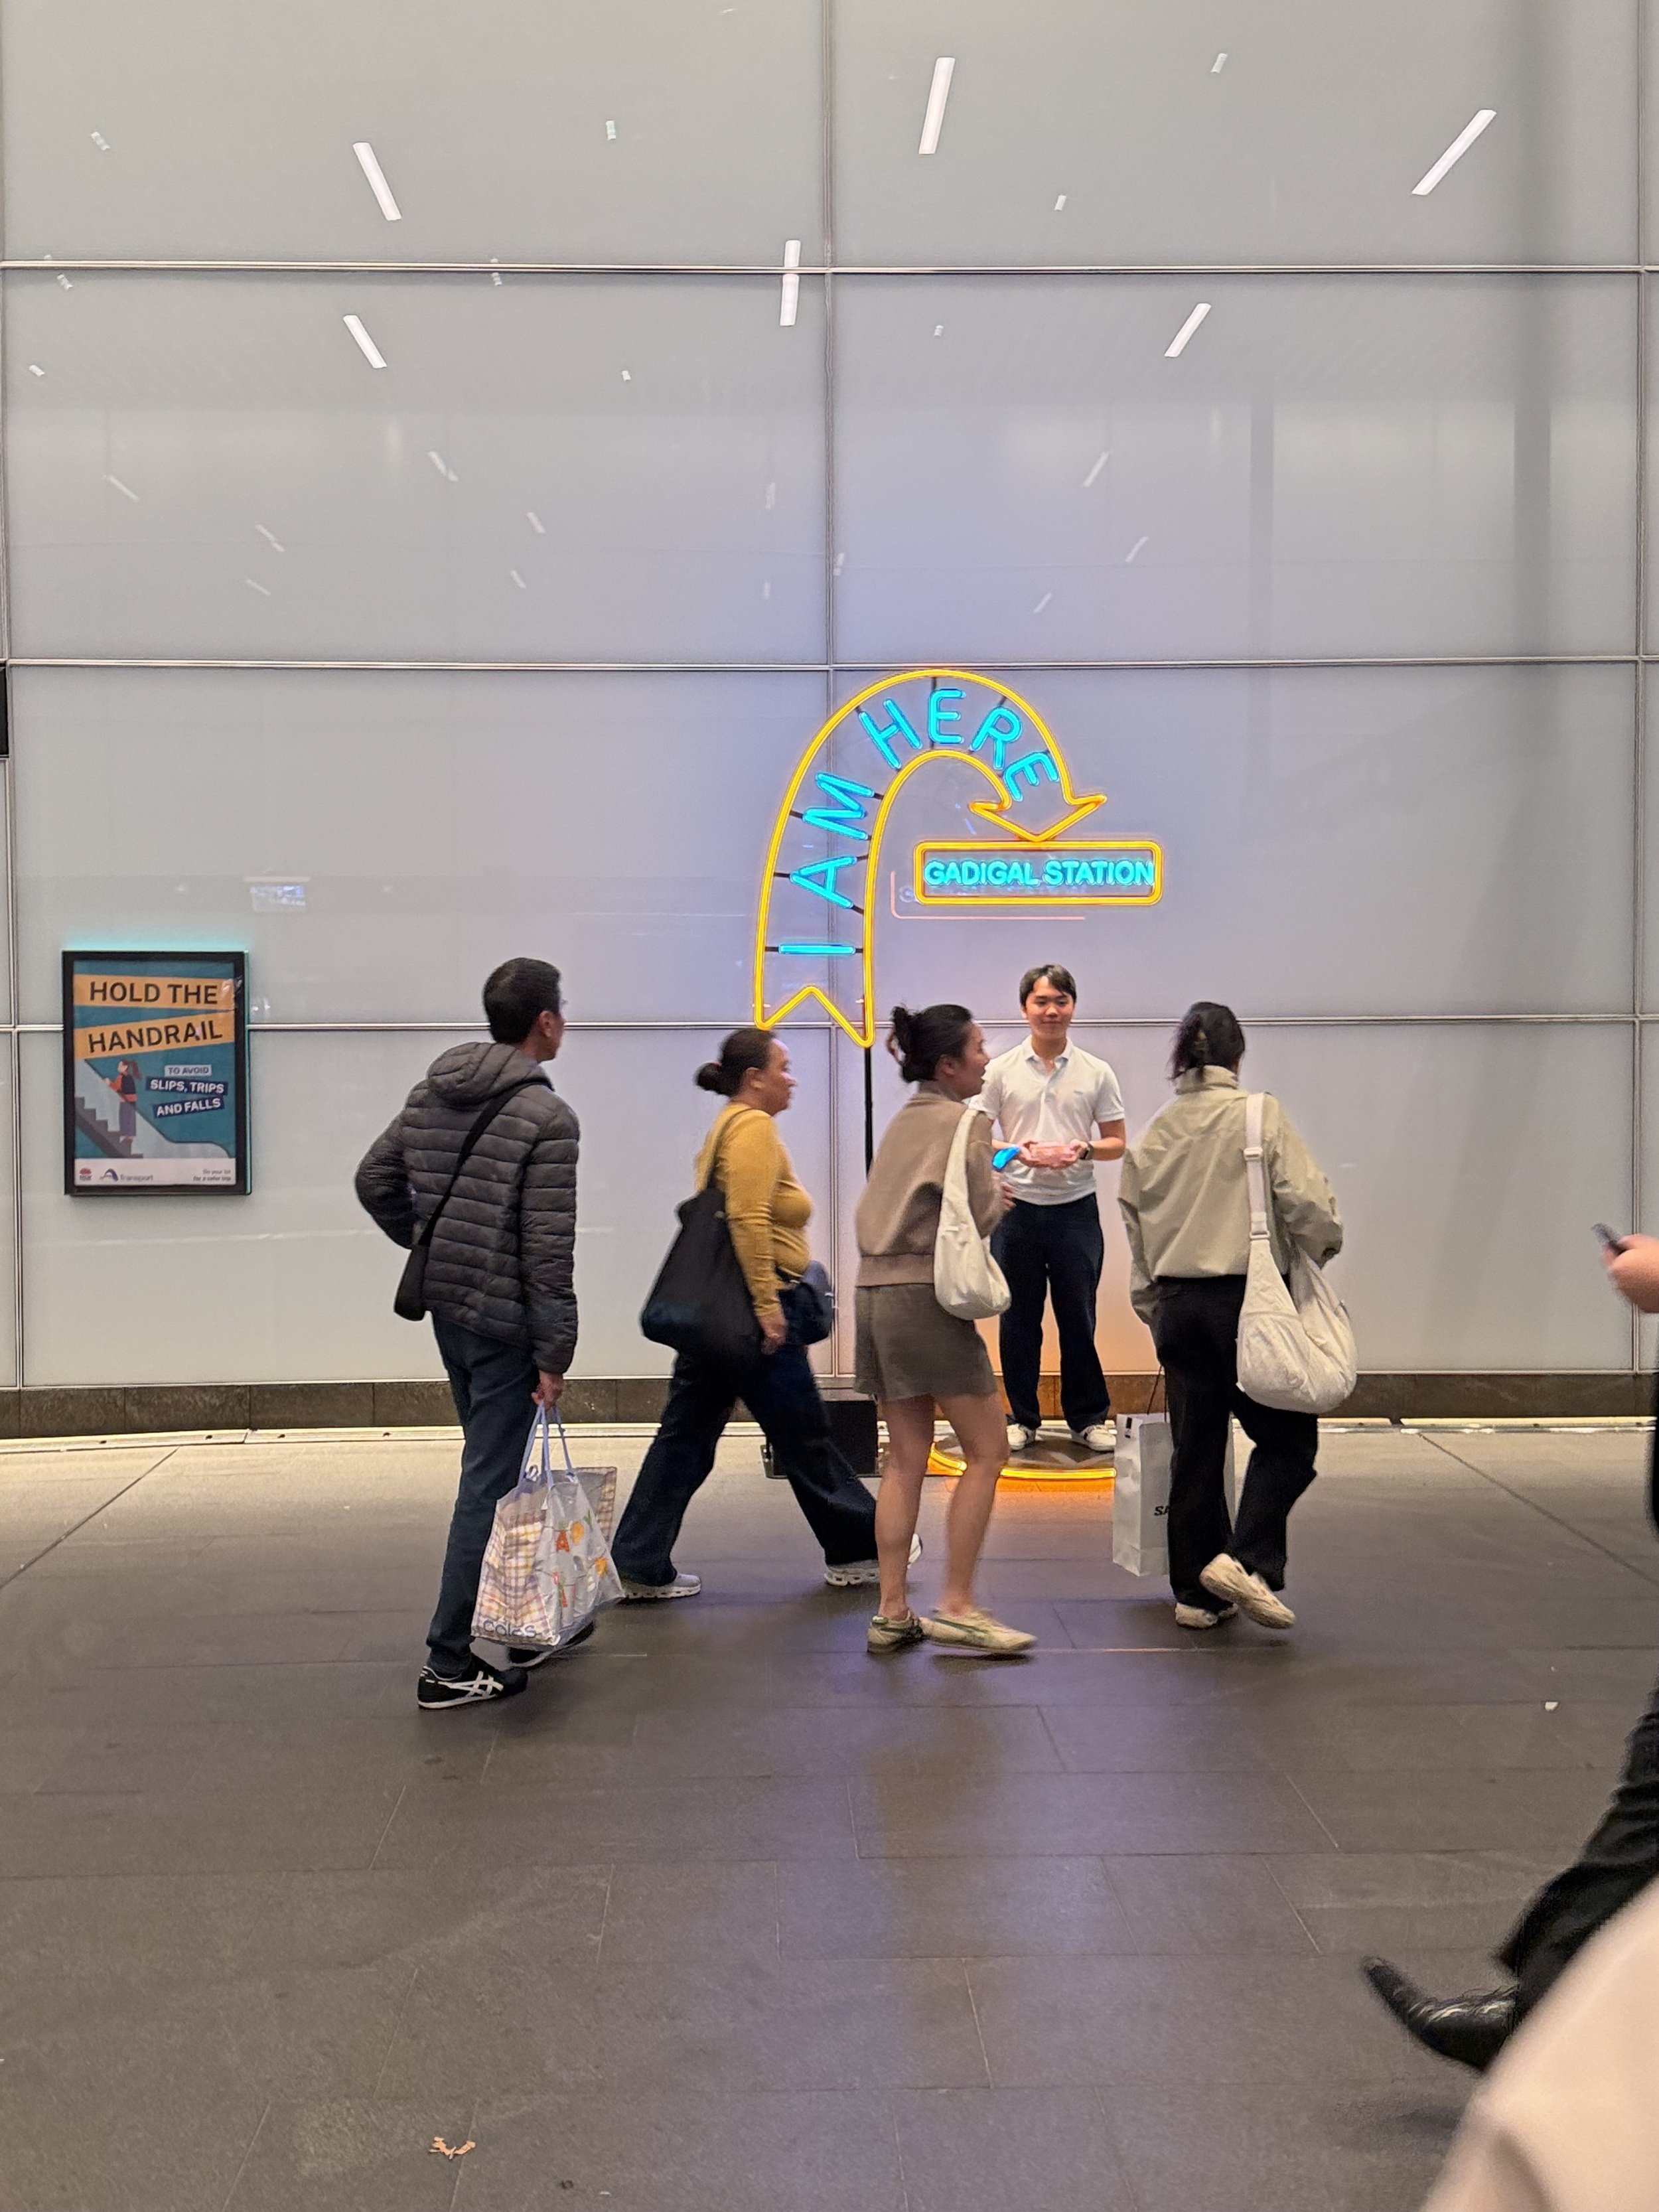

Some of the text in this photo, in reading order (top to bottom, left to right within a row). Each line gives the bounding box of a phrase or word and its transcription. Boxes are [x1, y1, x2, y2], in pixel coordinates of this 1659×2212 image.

[788, 772, 875, 909] AM
[858, 686, 1060, 801] HERE
[924, 859, 1155, 887] GADIGAL STATION
[90, 981, 218, 1005] HOLD THE
[88, 1019, 223, 1053] HANDRAIL
[150, 1079, 224, 1094] SLIPS, TRIPS
[157, 1098, 221, 1117] AND FALLS
